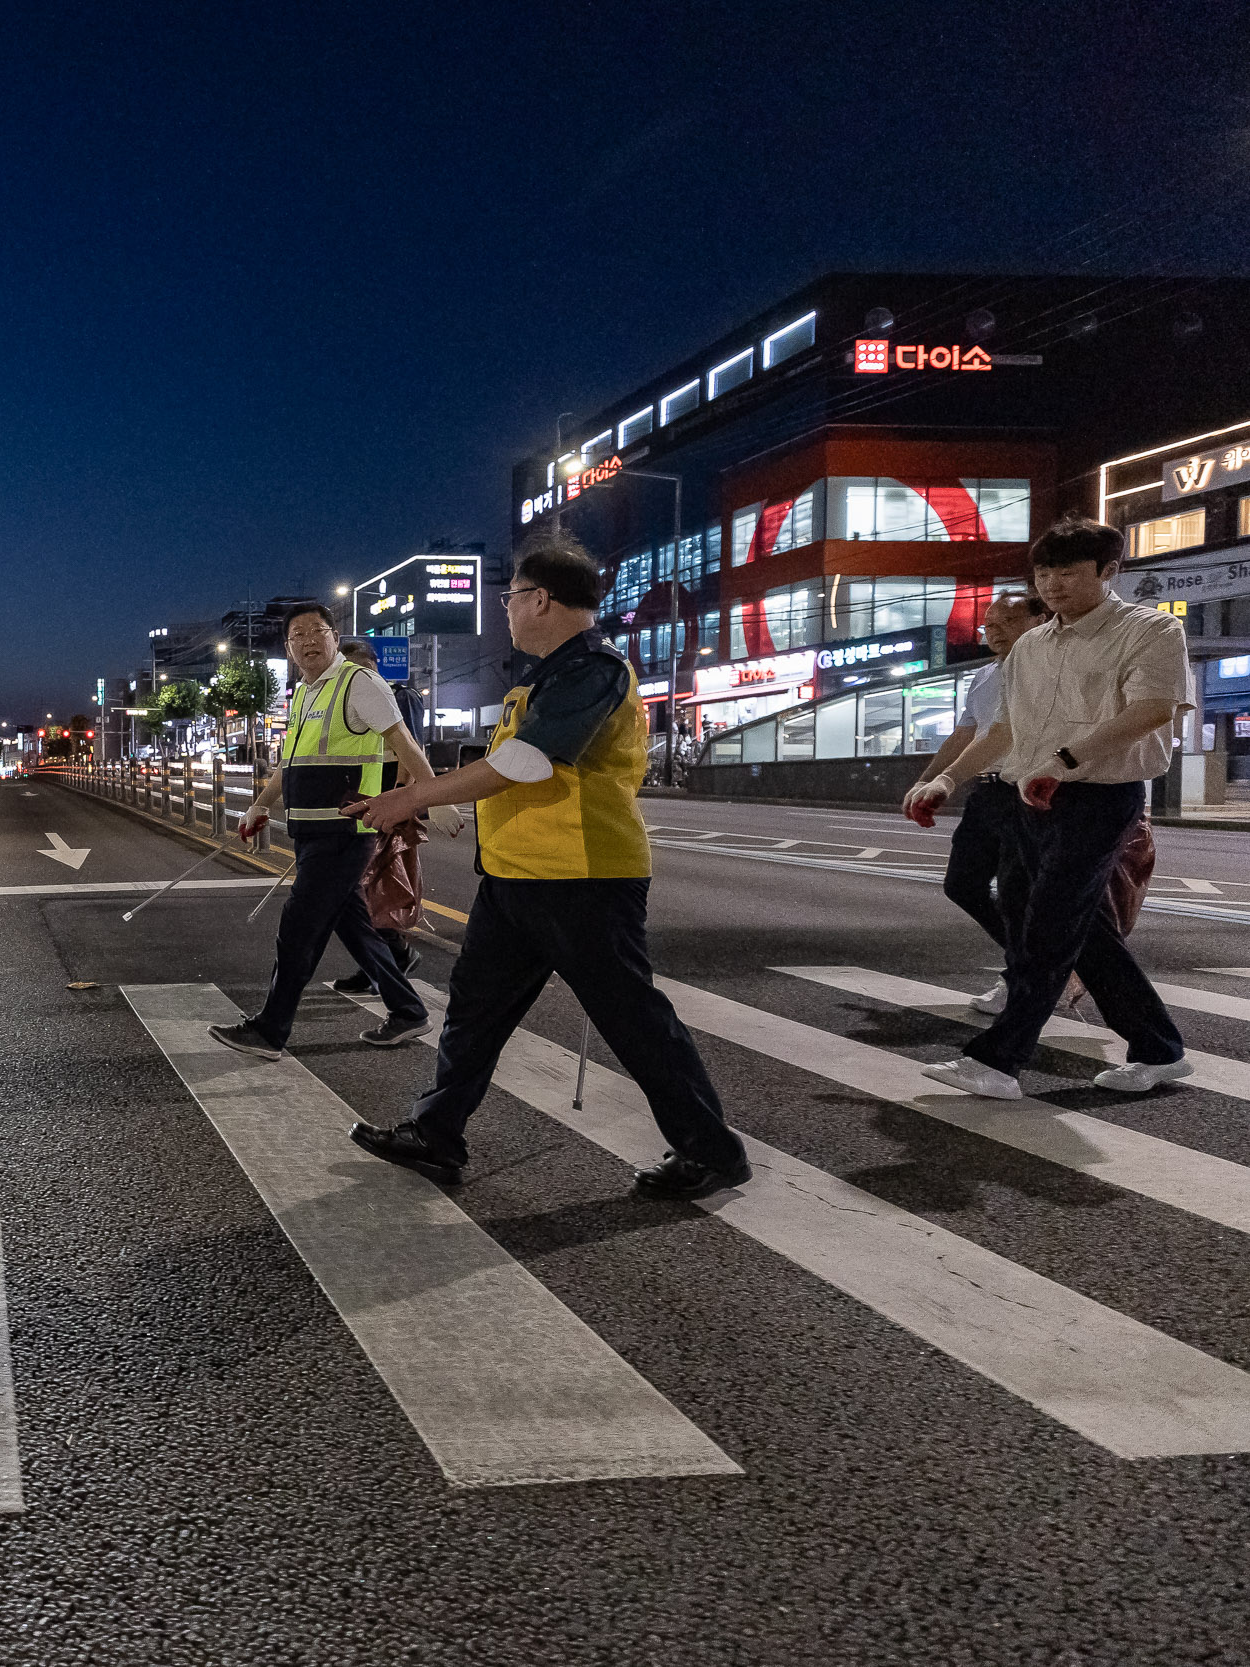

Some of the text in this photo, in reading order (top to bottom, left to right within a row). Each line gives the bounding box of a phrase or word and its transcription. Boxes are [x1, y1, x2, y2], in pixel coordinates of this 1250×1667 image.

[895, 344, 993, 371] 다이소
[582, 456, 622, 489] 다이소
[1167, 575, 1203, 591] Rose
[1227, 564, 1250, 580] Sh
[741, 667, 775, 682] 다이소
